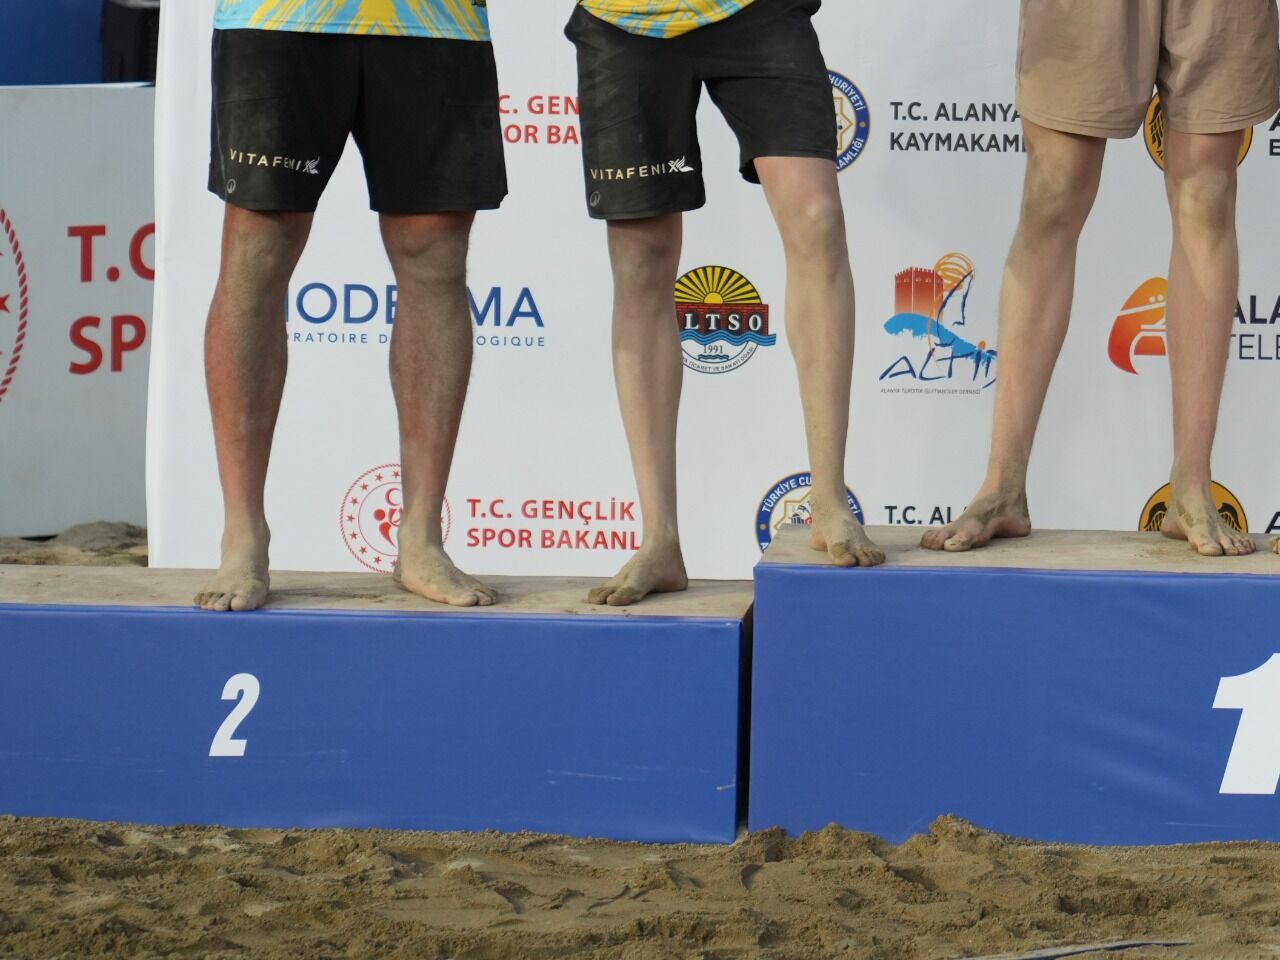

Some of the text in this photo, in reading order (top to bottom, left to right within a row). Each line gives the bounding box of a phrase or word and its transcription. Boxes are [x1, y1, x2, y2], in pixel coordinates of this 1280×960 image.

[890, 102, 928, 122] T.C.
[67, 224, 155, 283] T.C
[684, 313, 762, 331] LTSO
[68, 314, 146, 375] SP
[703, 345, 724, 354] 1991
[761, 478, 798, 513] TÜRKİYE
[467, 497, 635, 525] T.C. GENÇLİK
[885, 505, 922, 525] T.C.
[467, 528, 640, 551] SPOR BAKANL
[209, 673, 260, 757] 2
